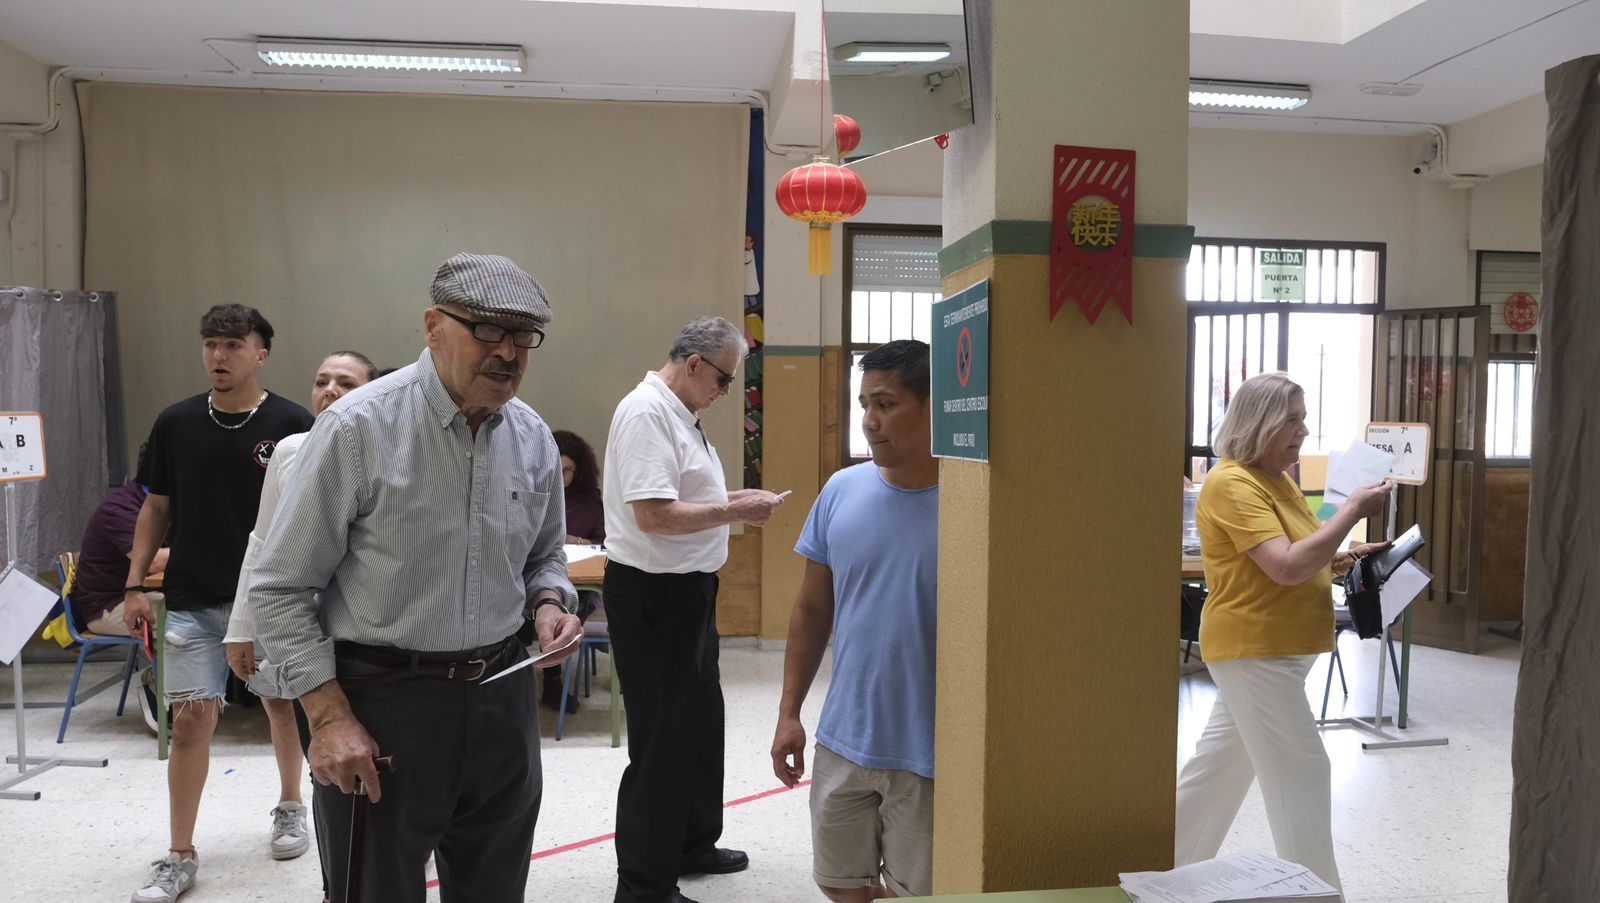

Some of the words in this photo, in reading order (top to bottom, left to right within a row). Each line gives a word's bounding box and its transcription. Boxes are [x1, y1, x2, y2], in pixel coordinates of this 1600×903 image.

[1071, 222, 1118, 246] 快乐
[1264, 252, 1300, 264] SALIDA
[16, 434, 26, 448] B
[1369, 443, 1394, 453] ESA
[1404, 442, 1412, 453] A
